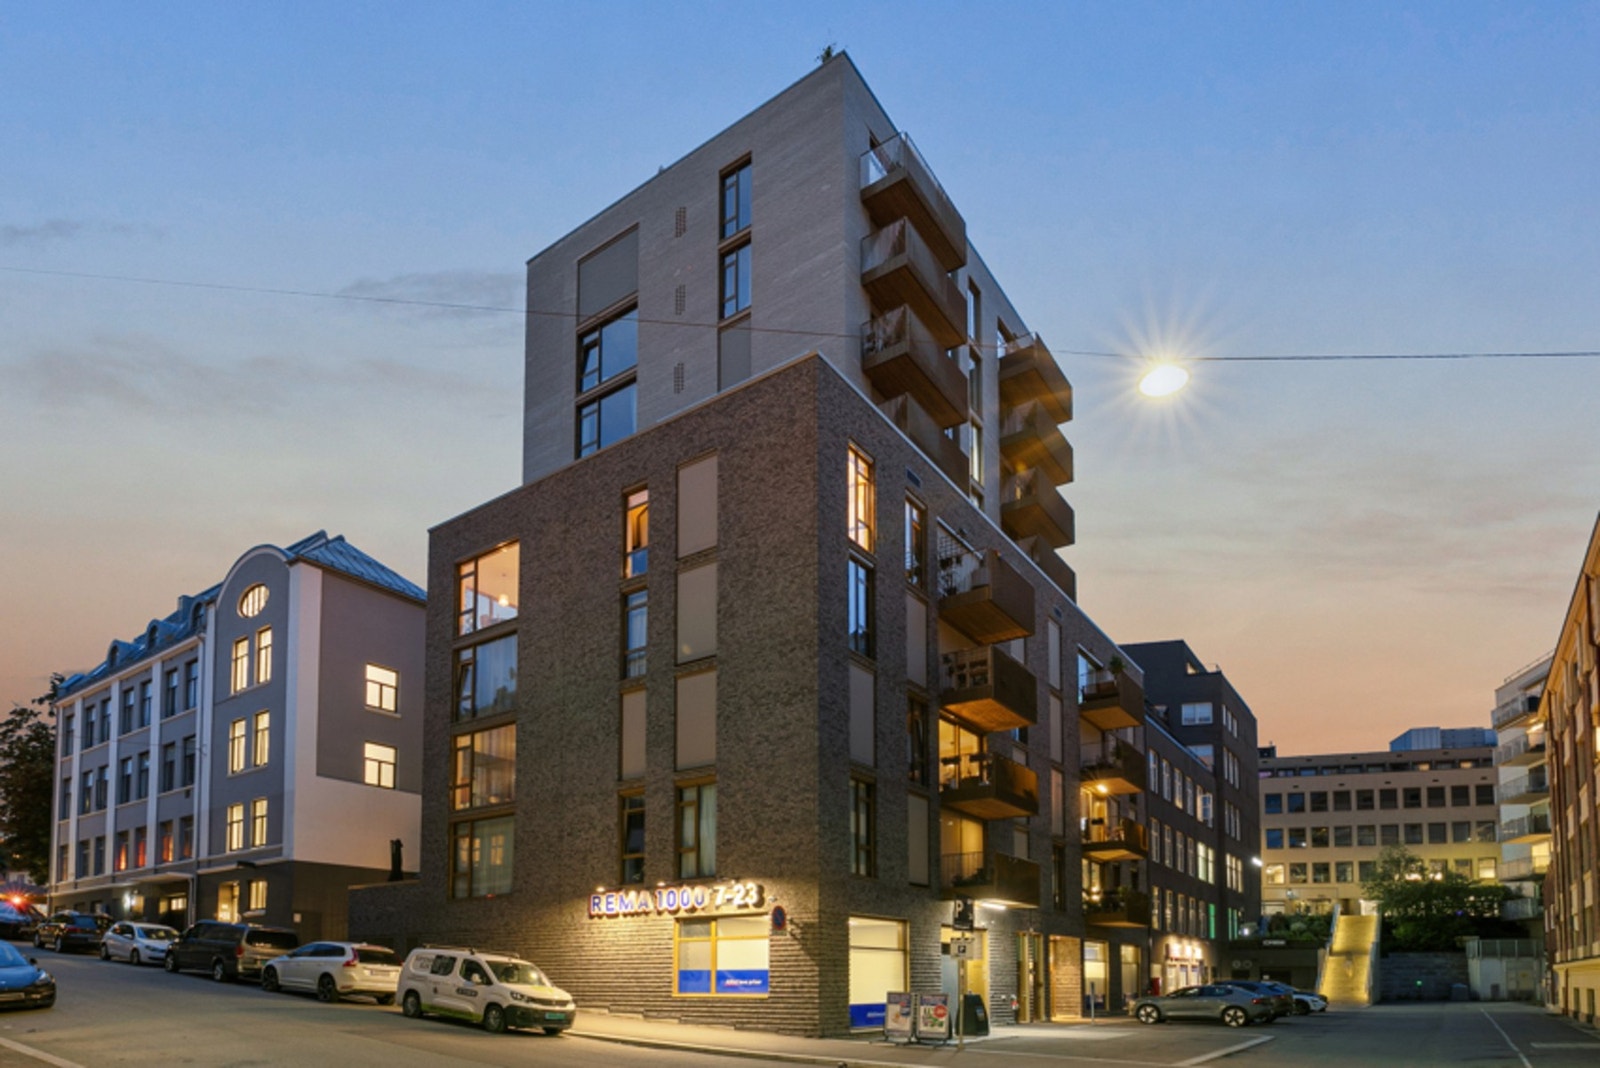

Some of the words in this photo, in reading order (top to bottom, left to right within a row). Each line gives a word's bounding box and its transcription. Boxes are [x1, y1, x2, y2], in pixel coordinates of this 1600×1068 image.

[590, 890, 652, 914] REMA
[656, 886, 709, 910] 1000
[714, 883, 759, 906] 7-23
[955, 900, 964, 918] P
